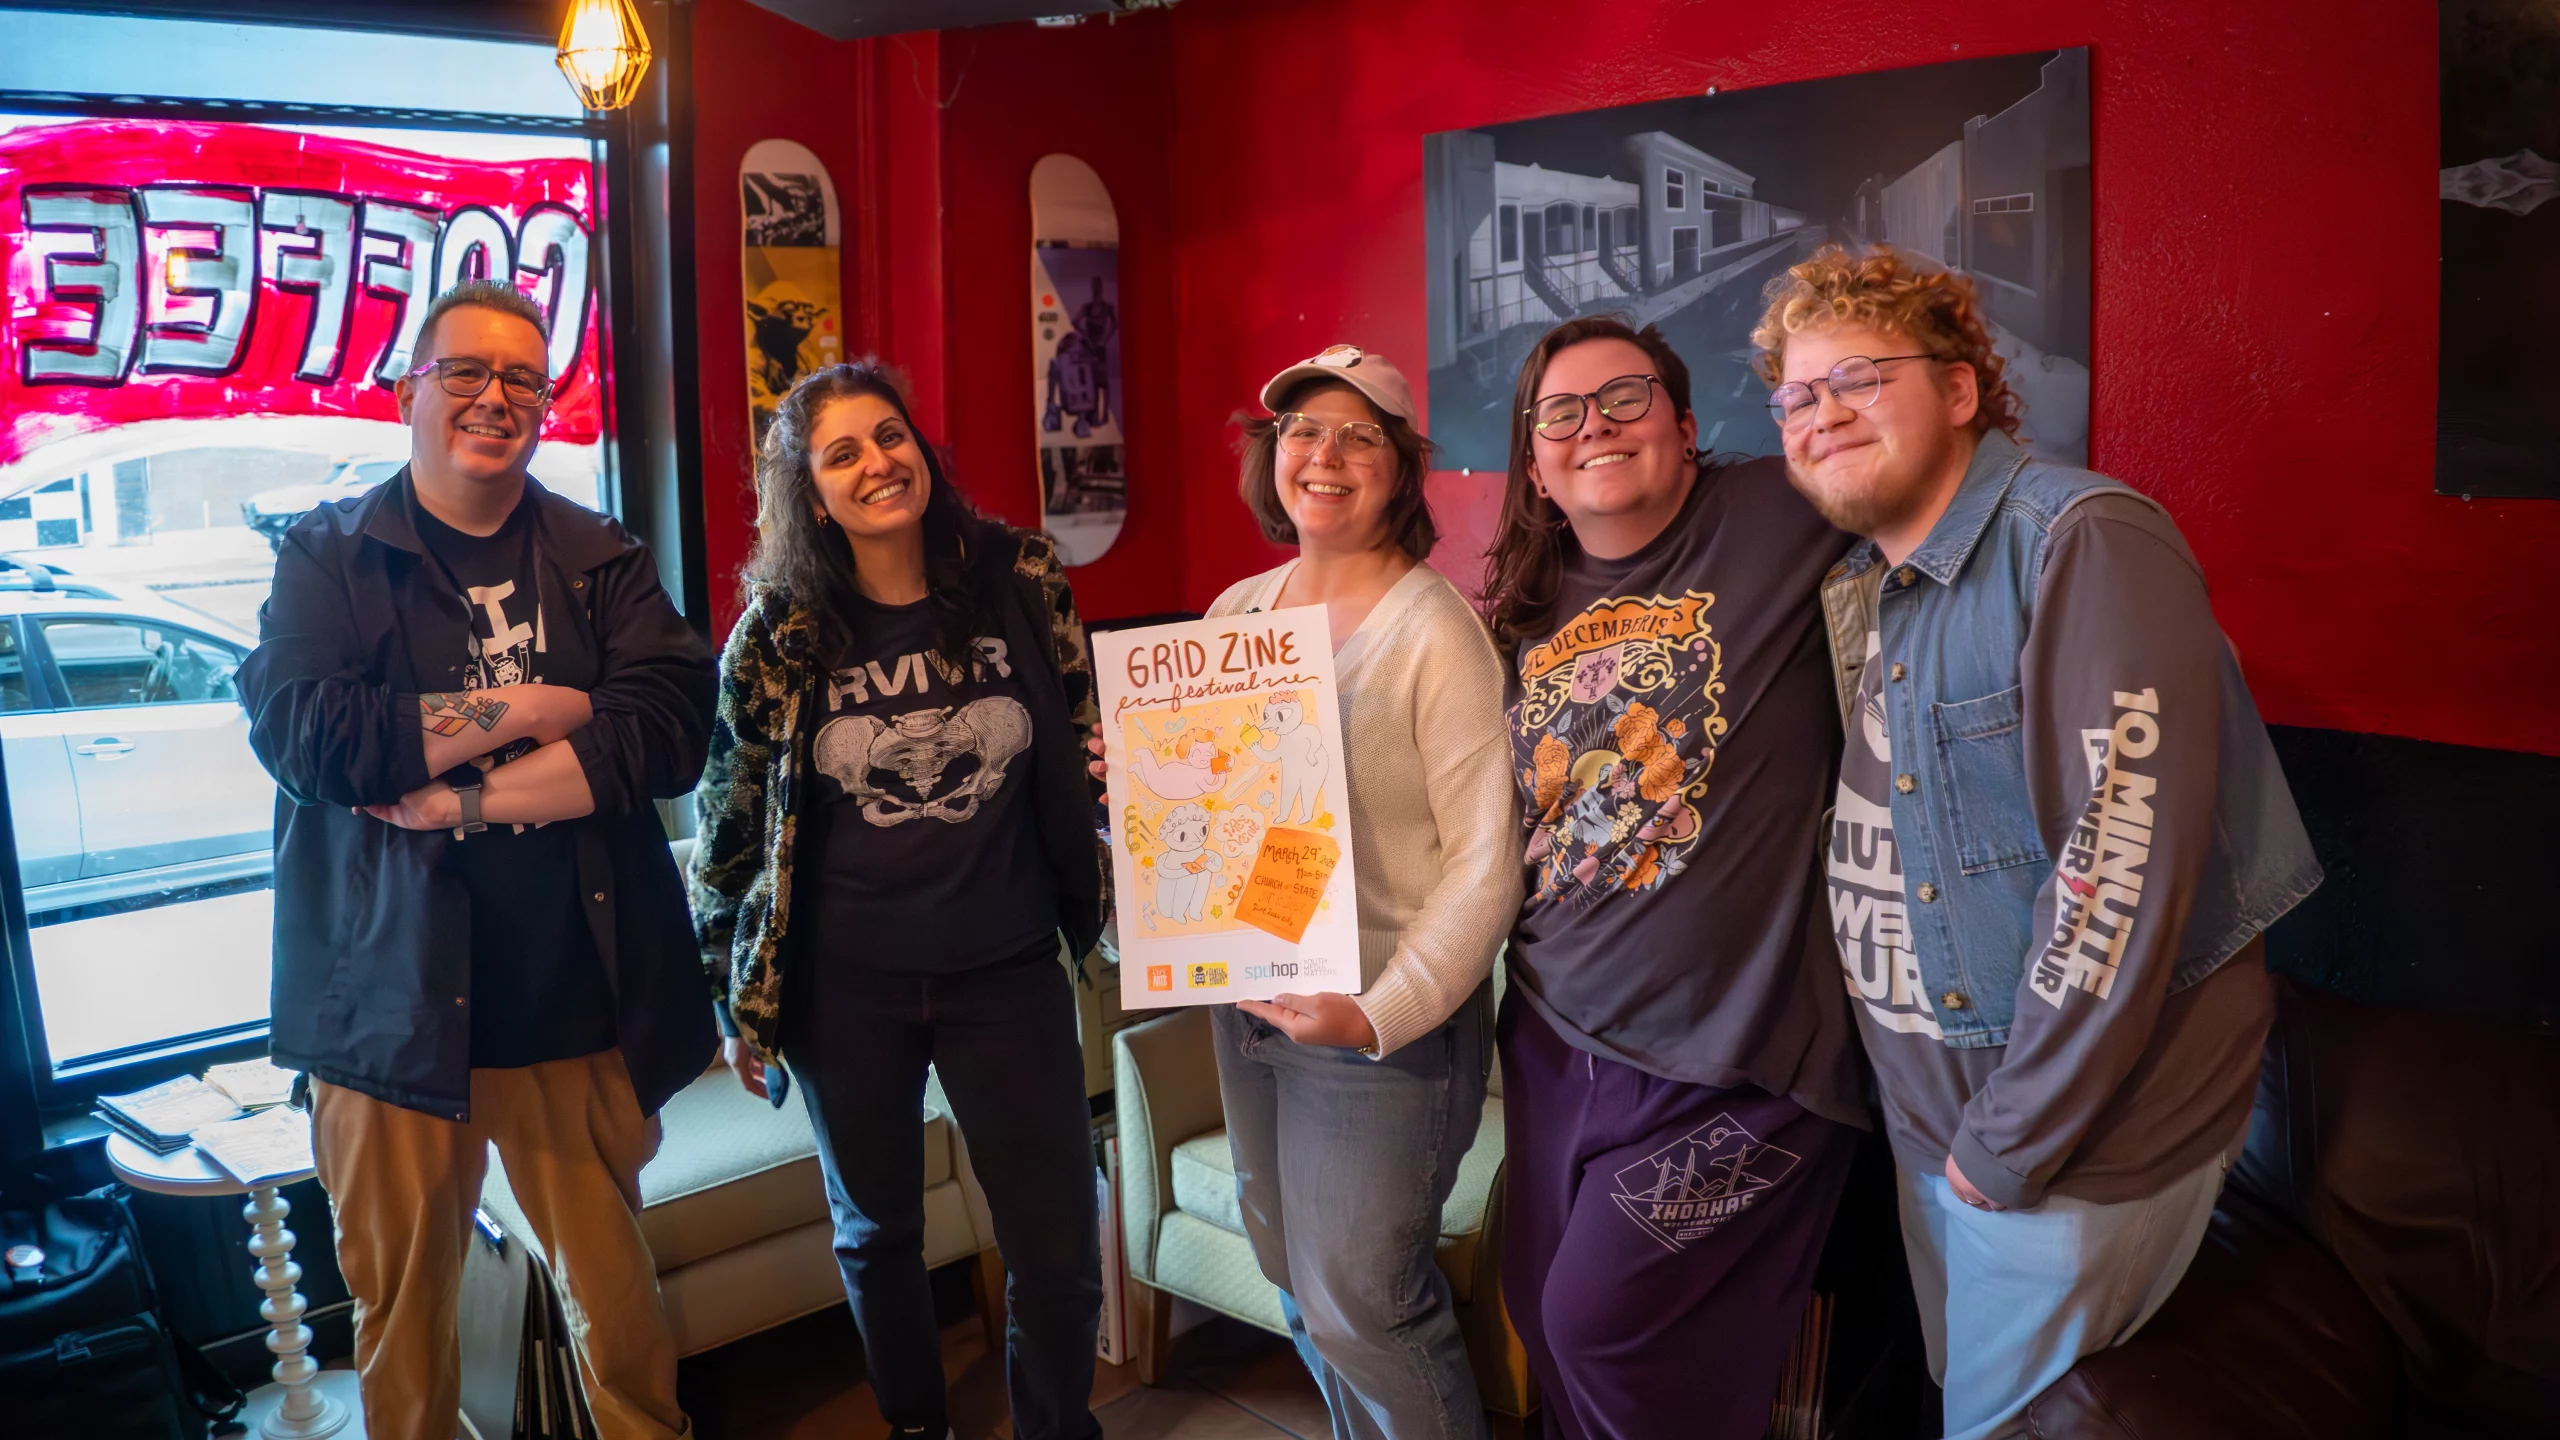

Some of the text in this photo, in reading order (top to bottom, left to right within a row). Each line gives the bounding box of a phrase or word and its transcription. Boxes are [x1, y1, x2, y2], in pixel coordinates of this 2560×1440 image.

[1170, 671, 1260, 714] festival
[1254, 875, 1319, 900] CHURCH STATE
[2034, 737, 2110, 995] POWER HOUR
[2067, 687, 2160, 1000] 10 MINUTE
